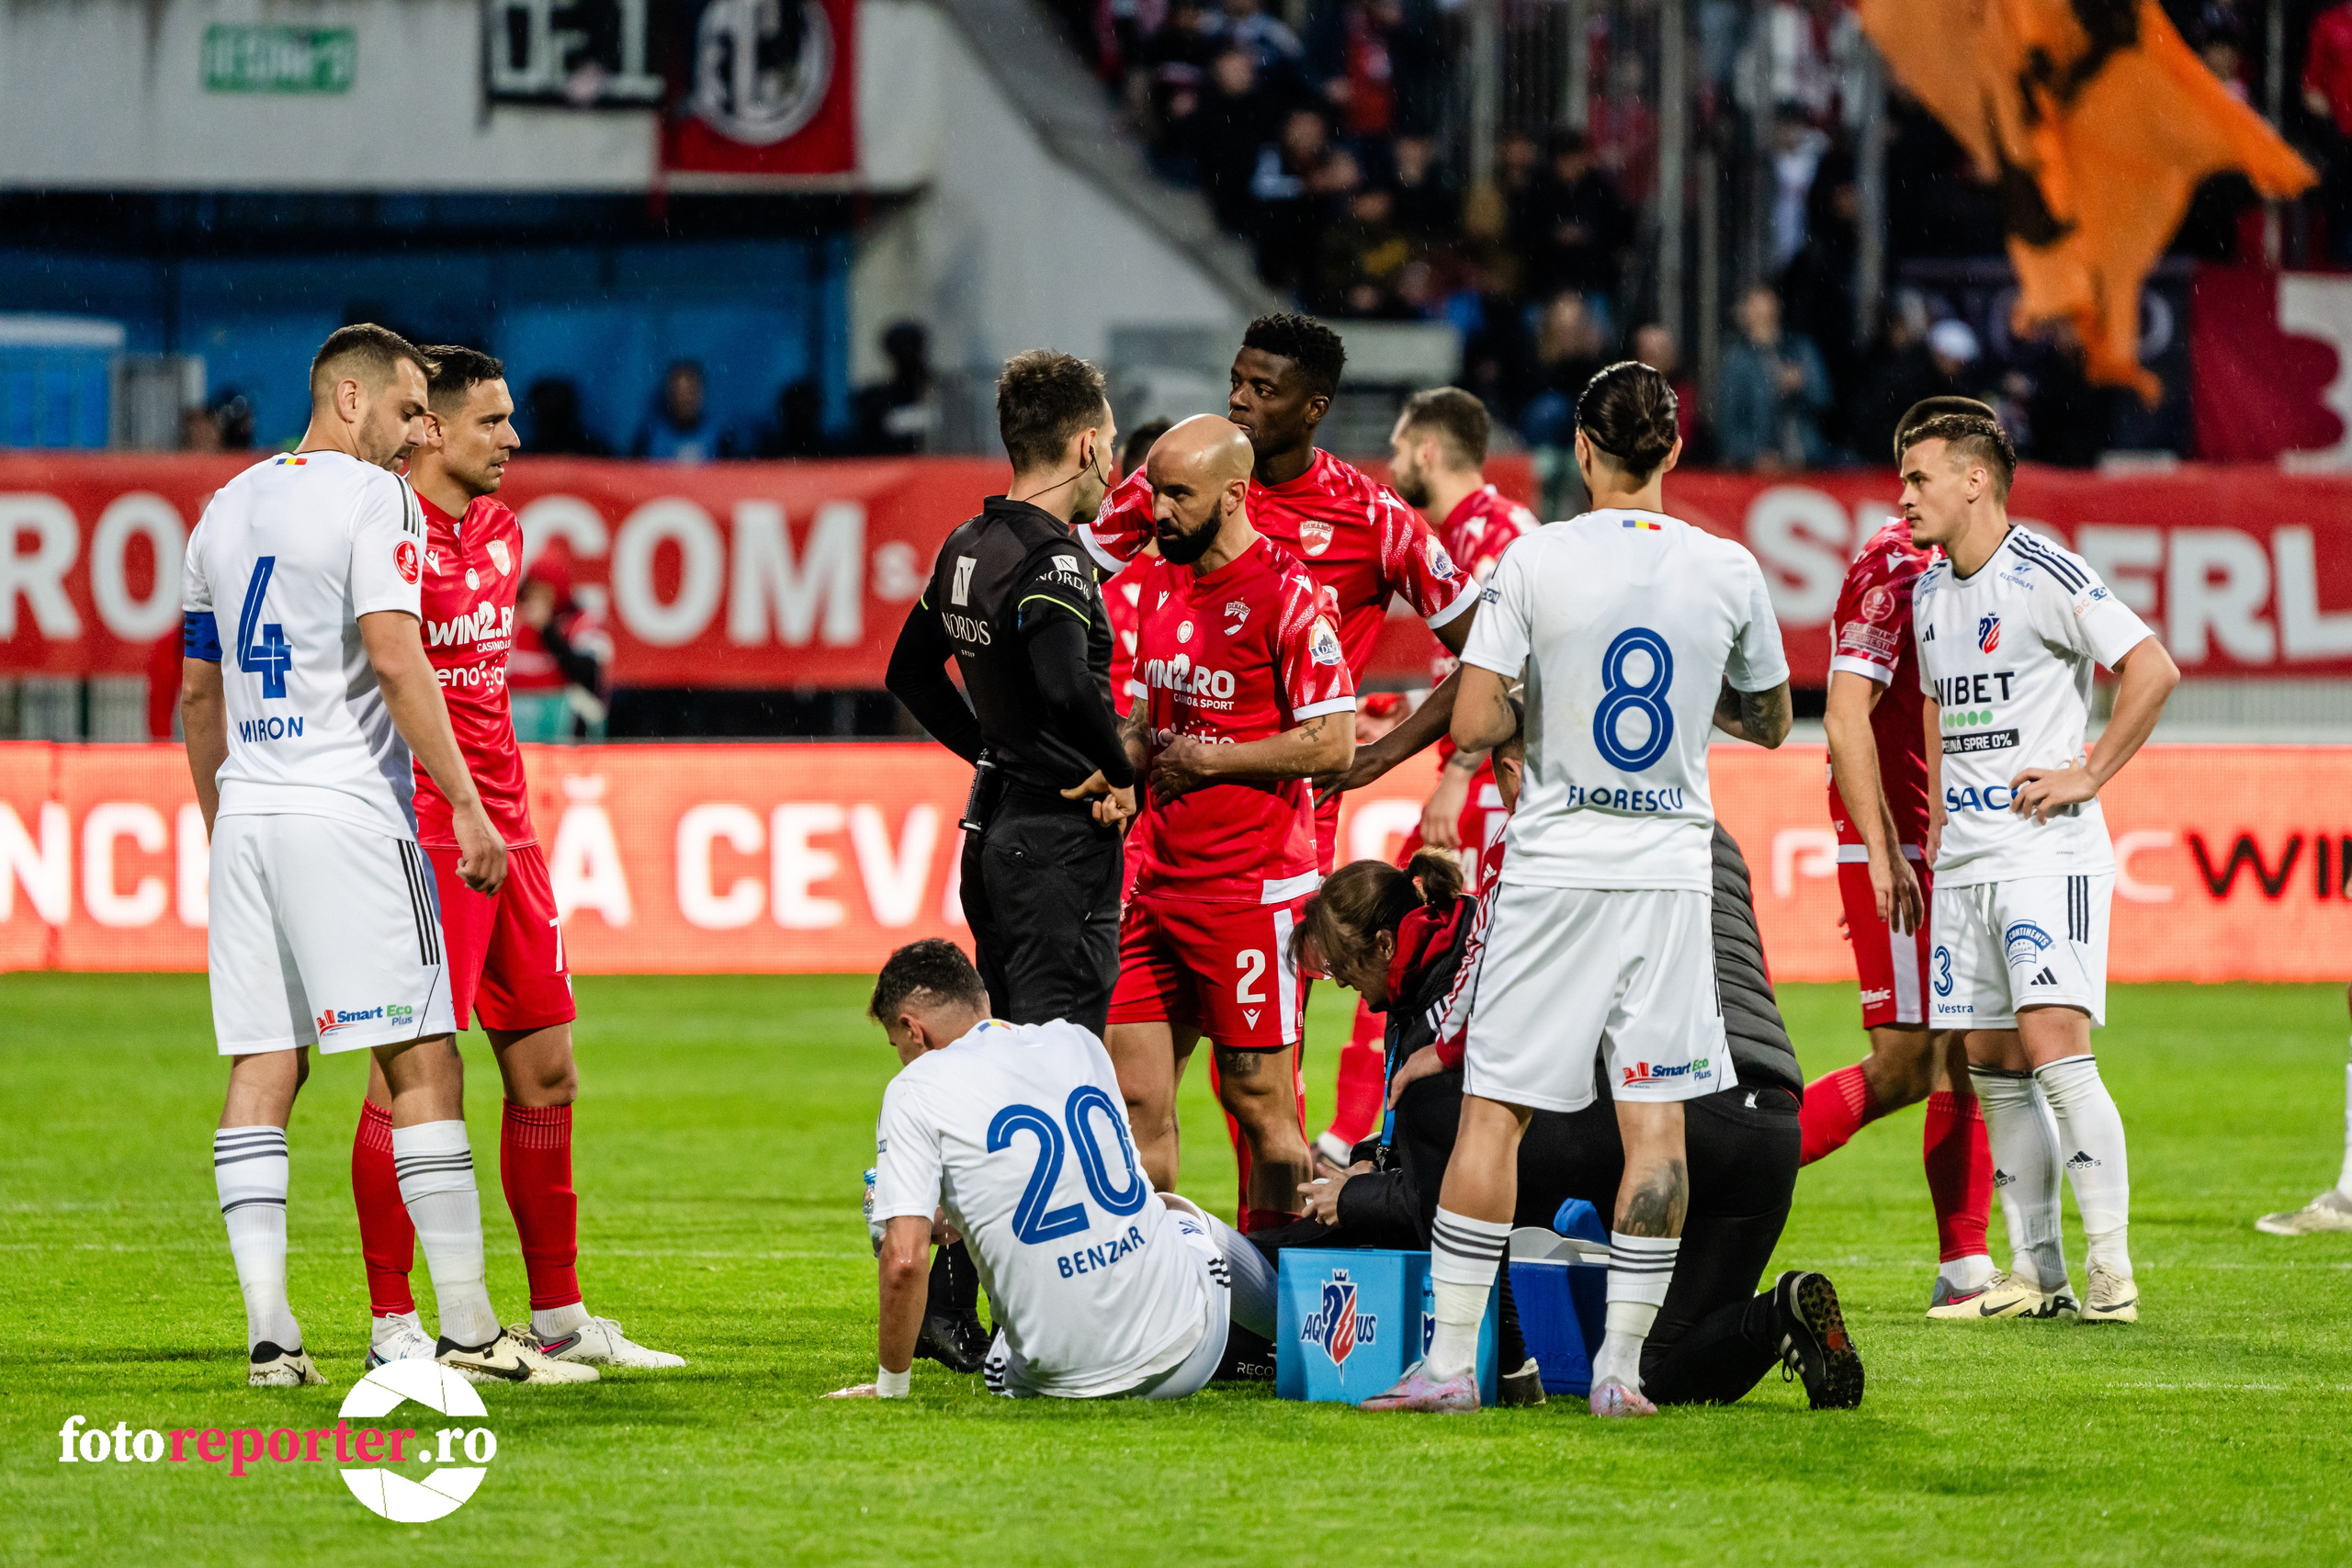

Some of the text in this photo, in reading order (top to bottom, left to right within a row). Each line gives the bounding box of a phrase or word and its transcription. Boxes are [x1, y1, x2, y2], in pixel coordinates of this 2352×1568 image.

[237, 556, 292, 699] 4
[942, 612, 991, 646] NORDIS
[1593, 627, 1675, 773] 8
[1935, 671, 2015, 707] NIBET
[1200, 698, 1235, 711] SPORT
[239, 716, 304, 744] MIRON
[1963, 736, 1991, 751] SPRE
[1991, 732, 2013, 748] 0%
[1566, 784, 1684, 813] FLORESCU
[675, 800, 965, 930] CEV
[2008, 926, 2050, 947] CONTINENTS
[1236, 948, 1266, 1004] 2
[336, 1004, 413, 1023] Smart Eco
[391, 1016, 413, 1026] Plus
[1937, 1002, 1974, 1014] Vestra
[1651, 1057, 1709, 1077] Smart Eco
[1694, 1069, 1712, 1081] Plus
[986, 1084, 1147, 1246] 20
[1057, 1225, 1147, 1279] BENZAR
[1237, 1361, 1274, 1377] RECO
